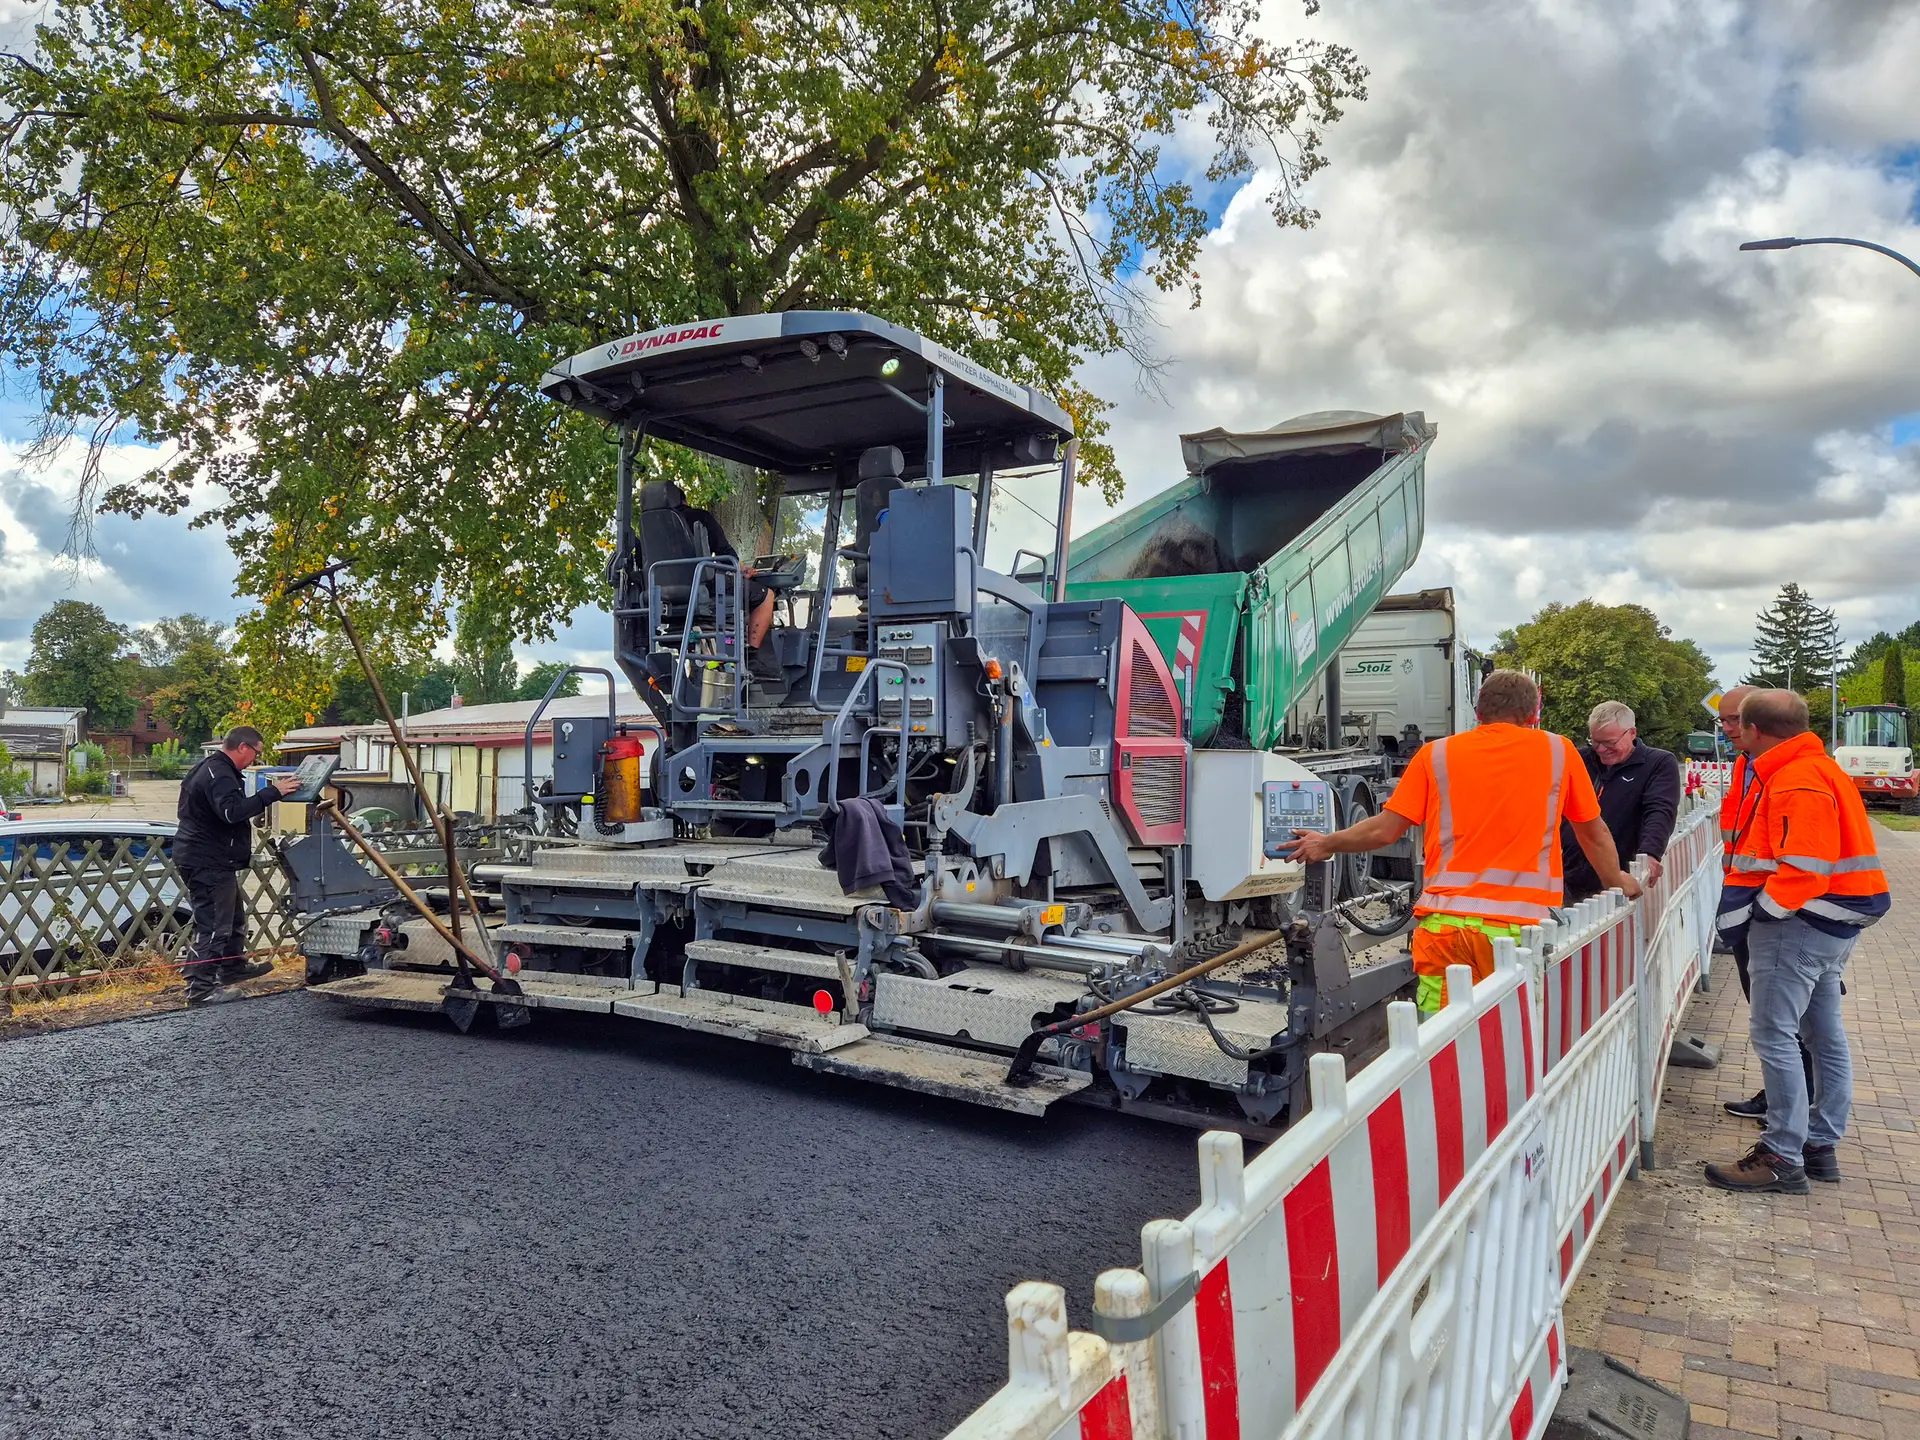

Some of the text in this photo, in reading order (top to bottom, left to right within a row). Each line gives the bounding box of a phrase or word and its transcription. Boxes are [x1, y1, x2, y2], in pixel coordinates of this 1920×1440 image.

[621, 324, 724, 355] DYNAPAC
[938, 350, 1017, 398] PRIGNITZER ASPHALTBAU
[1356, 660, 1393, 673] Stolz
